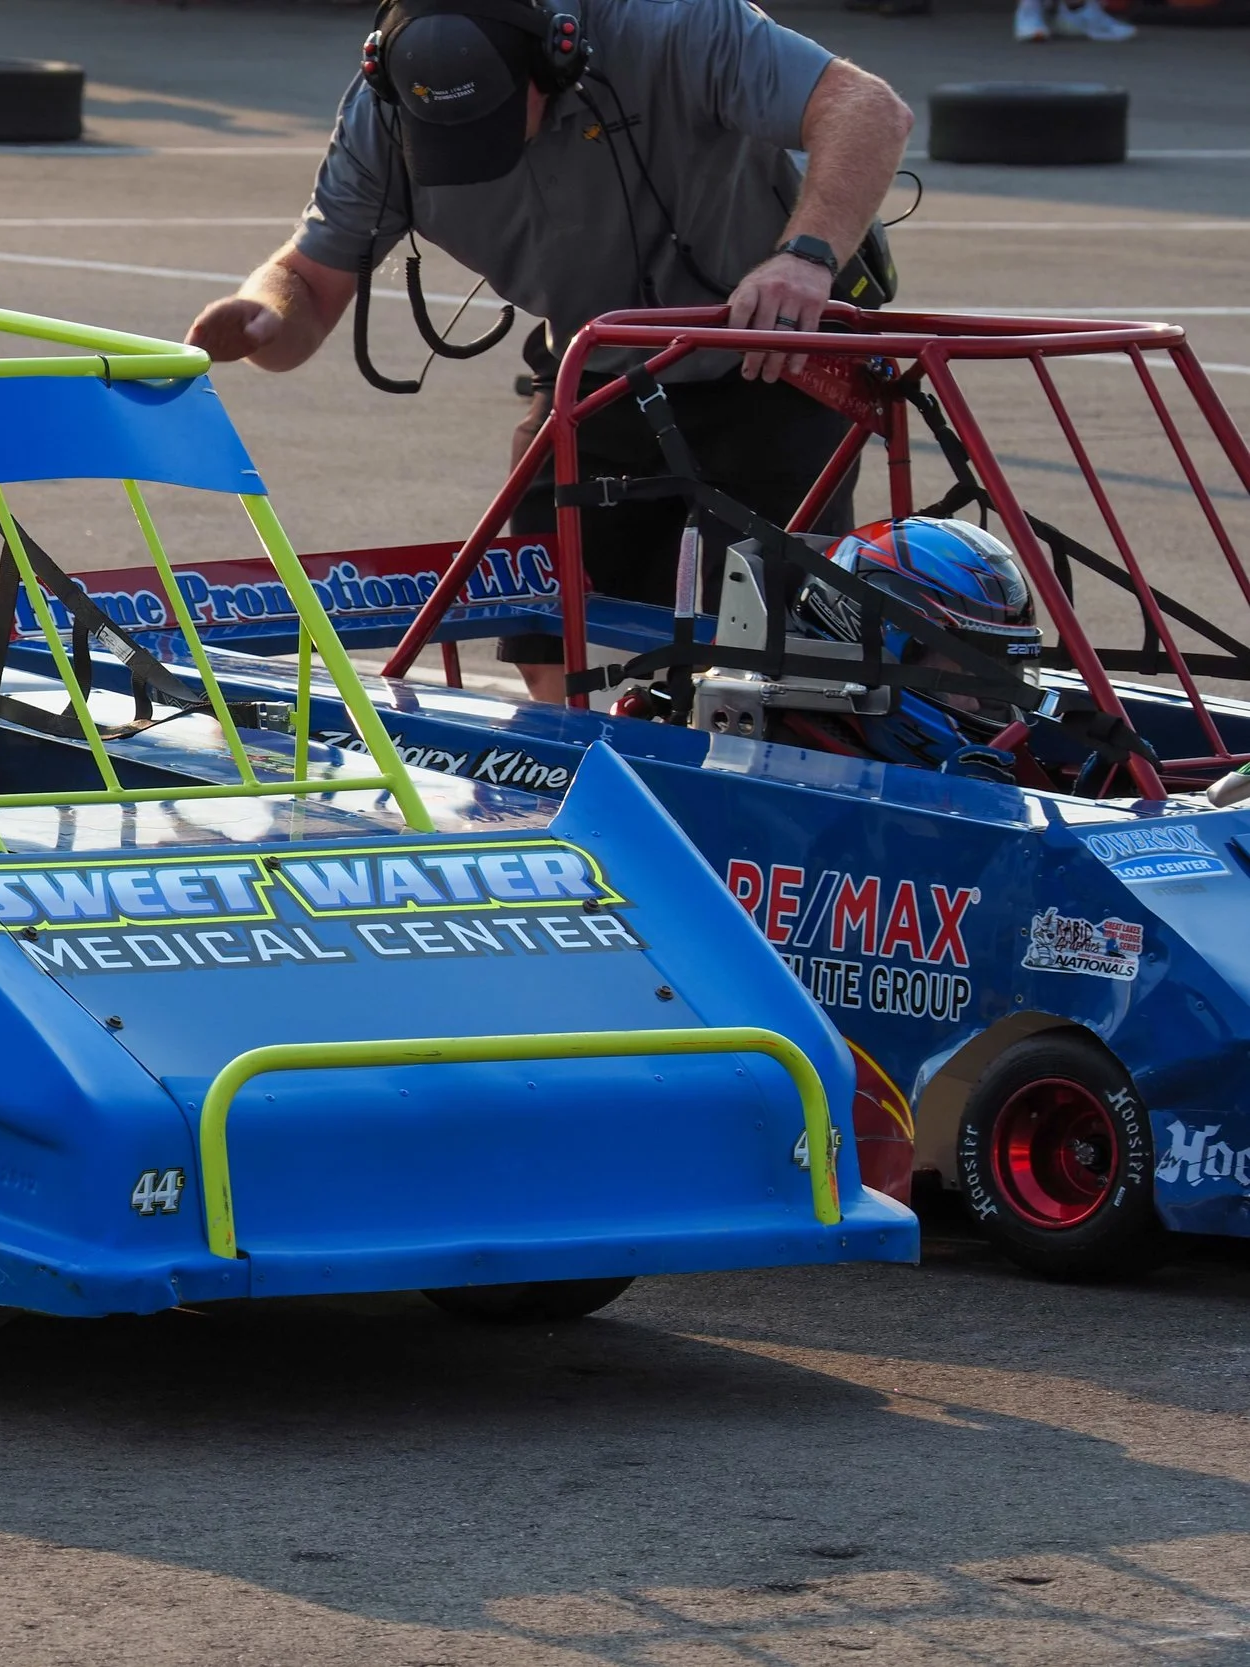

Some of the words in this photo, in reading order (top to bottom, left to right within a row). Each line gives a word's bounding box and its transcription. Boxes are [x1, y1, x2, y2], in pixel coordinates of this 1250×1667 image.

[474, 745, 569, 788] Kline
[281, 851, 596, 908] WATER
[1157, 859, 1212, 874] CENTER
[17, 926, 347, 976] MEDICAL
[355, 914, 639, 956] CENTER
[1055, 954, 1135, 977] NATIONALS
[869, 964, 972, 1022] GROUP
[1105, 1087, 1149, 1185] Hoosier
[966, 1123, 999, 1221] Hoosier
